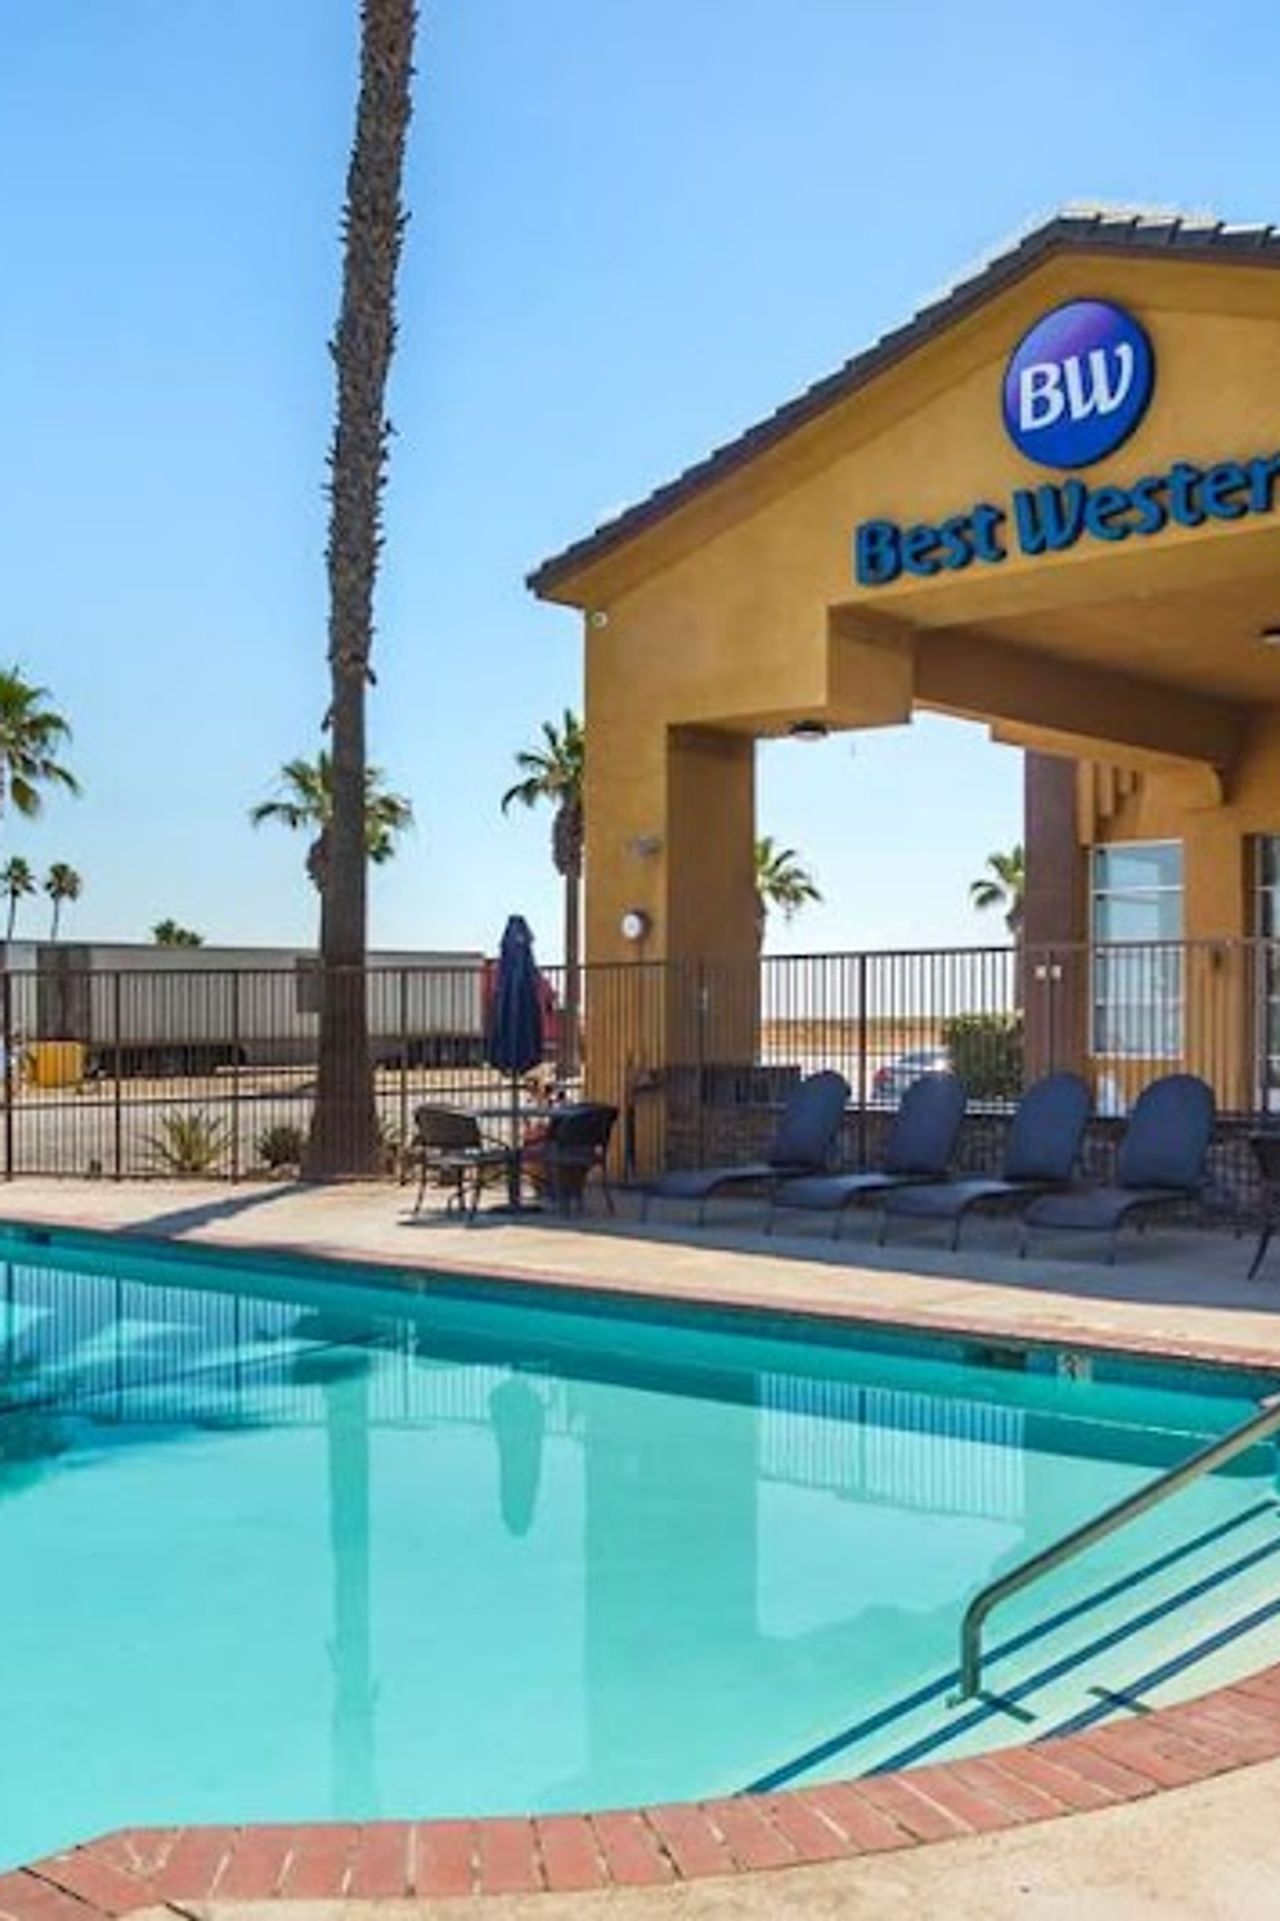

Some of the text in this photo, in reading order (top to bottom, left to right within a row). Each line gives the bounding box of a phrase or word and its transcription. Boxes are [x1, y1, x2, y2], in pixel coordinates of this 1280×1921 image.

[1019, 342, 1134, 432] BW
[856, 452, 1280, 585] Best Wester
